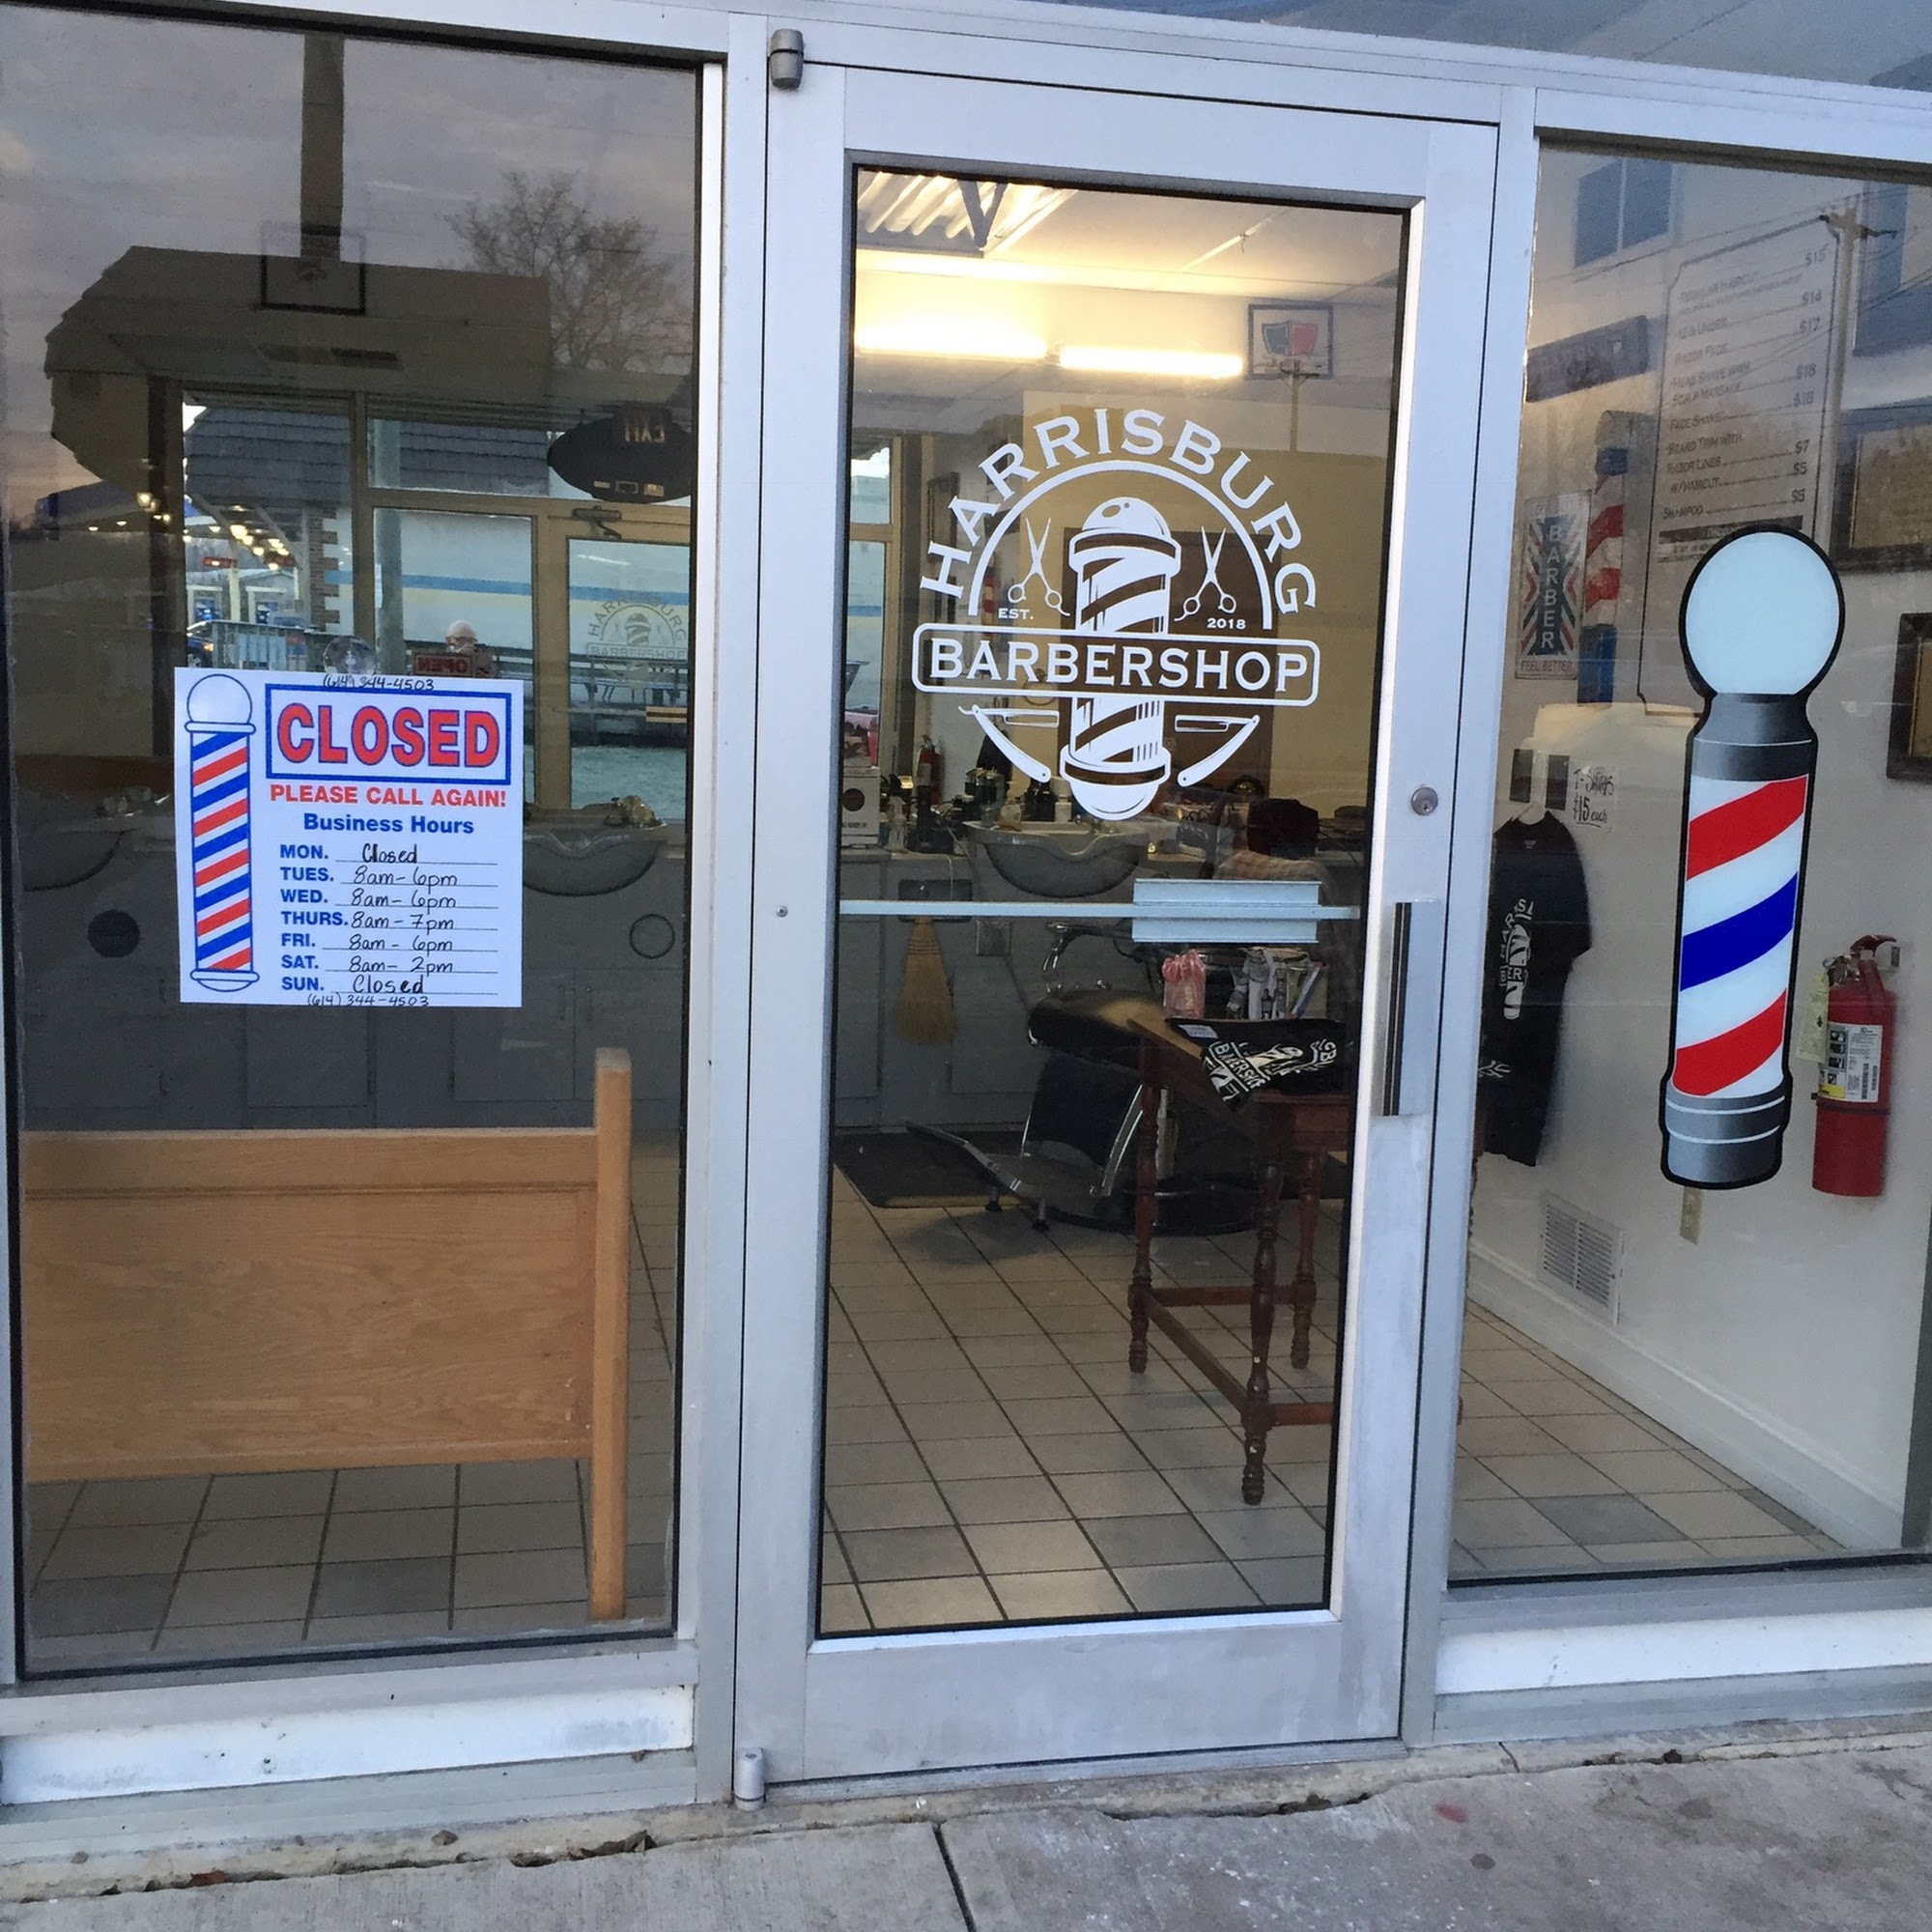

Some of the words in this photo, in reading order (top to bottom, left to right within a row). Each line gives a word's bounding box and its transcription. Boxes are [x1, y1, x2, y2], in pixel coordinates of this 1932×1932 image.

[1804, 248, 1827, 265] $15
[1799, 317, 1821, 333] $17
[1795, 361, 1816, 379] $18
[1794, 440, 1809, 452] $7
[1793, 462, 1807, 474] $5
[1791, 490, 1805, 501] $5
[920, 409, 1317, 614] HARRISBURG
[1541, 525, 1563, 649] BARBER
[587, 593, 687, 641] HARRBURG
[998, 608, 1034, 620] EST.
[1207, 618, 1246, 630] 2018
[930, 638, 1307, 693] BARBERSHOP
[277, 703, 499, 767] CLOSED
[270, 784, 357, 804] PLEASE
[366, 787, 423, 805] CALL
[431, 789, 506, 807] AGAIN!
[304, 813, 403, 832] Business
[412, 816, 474, 834] Hours
[280, 844, 328, 859] MON.
[362, 843, 417, 864] Closed
[281, 867, 334, 881] TUES.
[281, 889, 327, 902] WED.
[281, 911, 348, 925] THURS.
[282, 933, 315, 947] FRI.
[281, 955, 319, 969] SAT.
[282, 977, 325, 990] SUN.
[353, 975, 423, 993] Closed
[307, 992, 342, 1006] (614)
